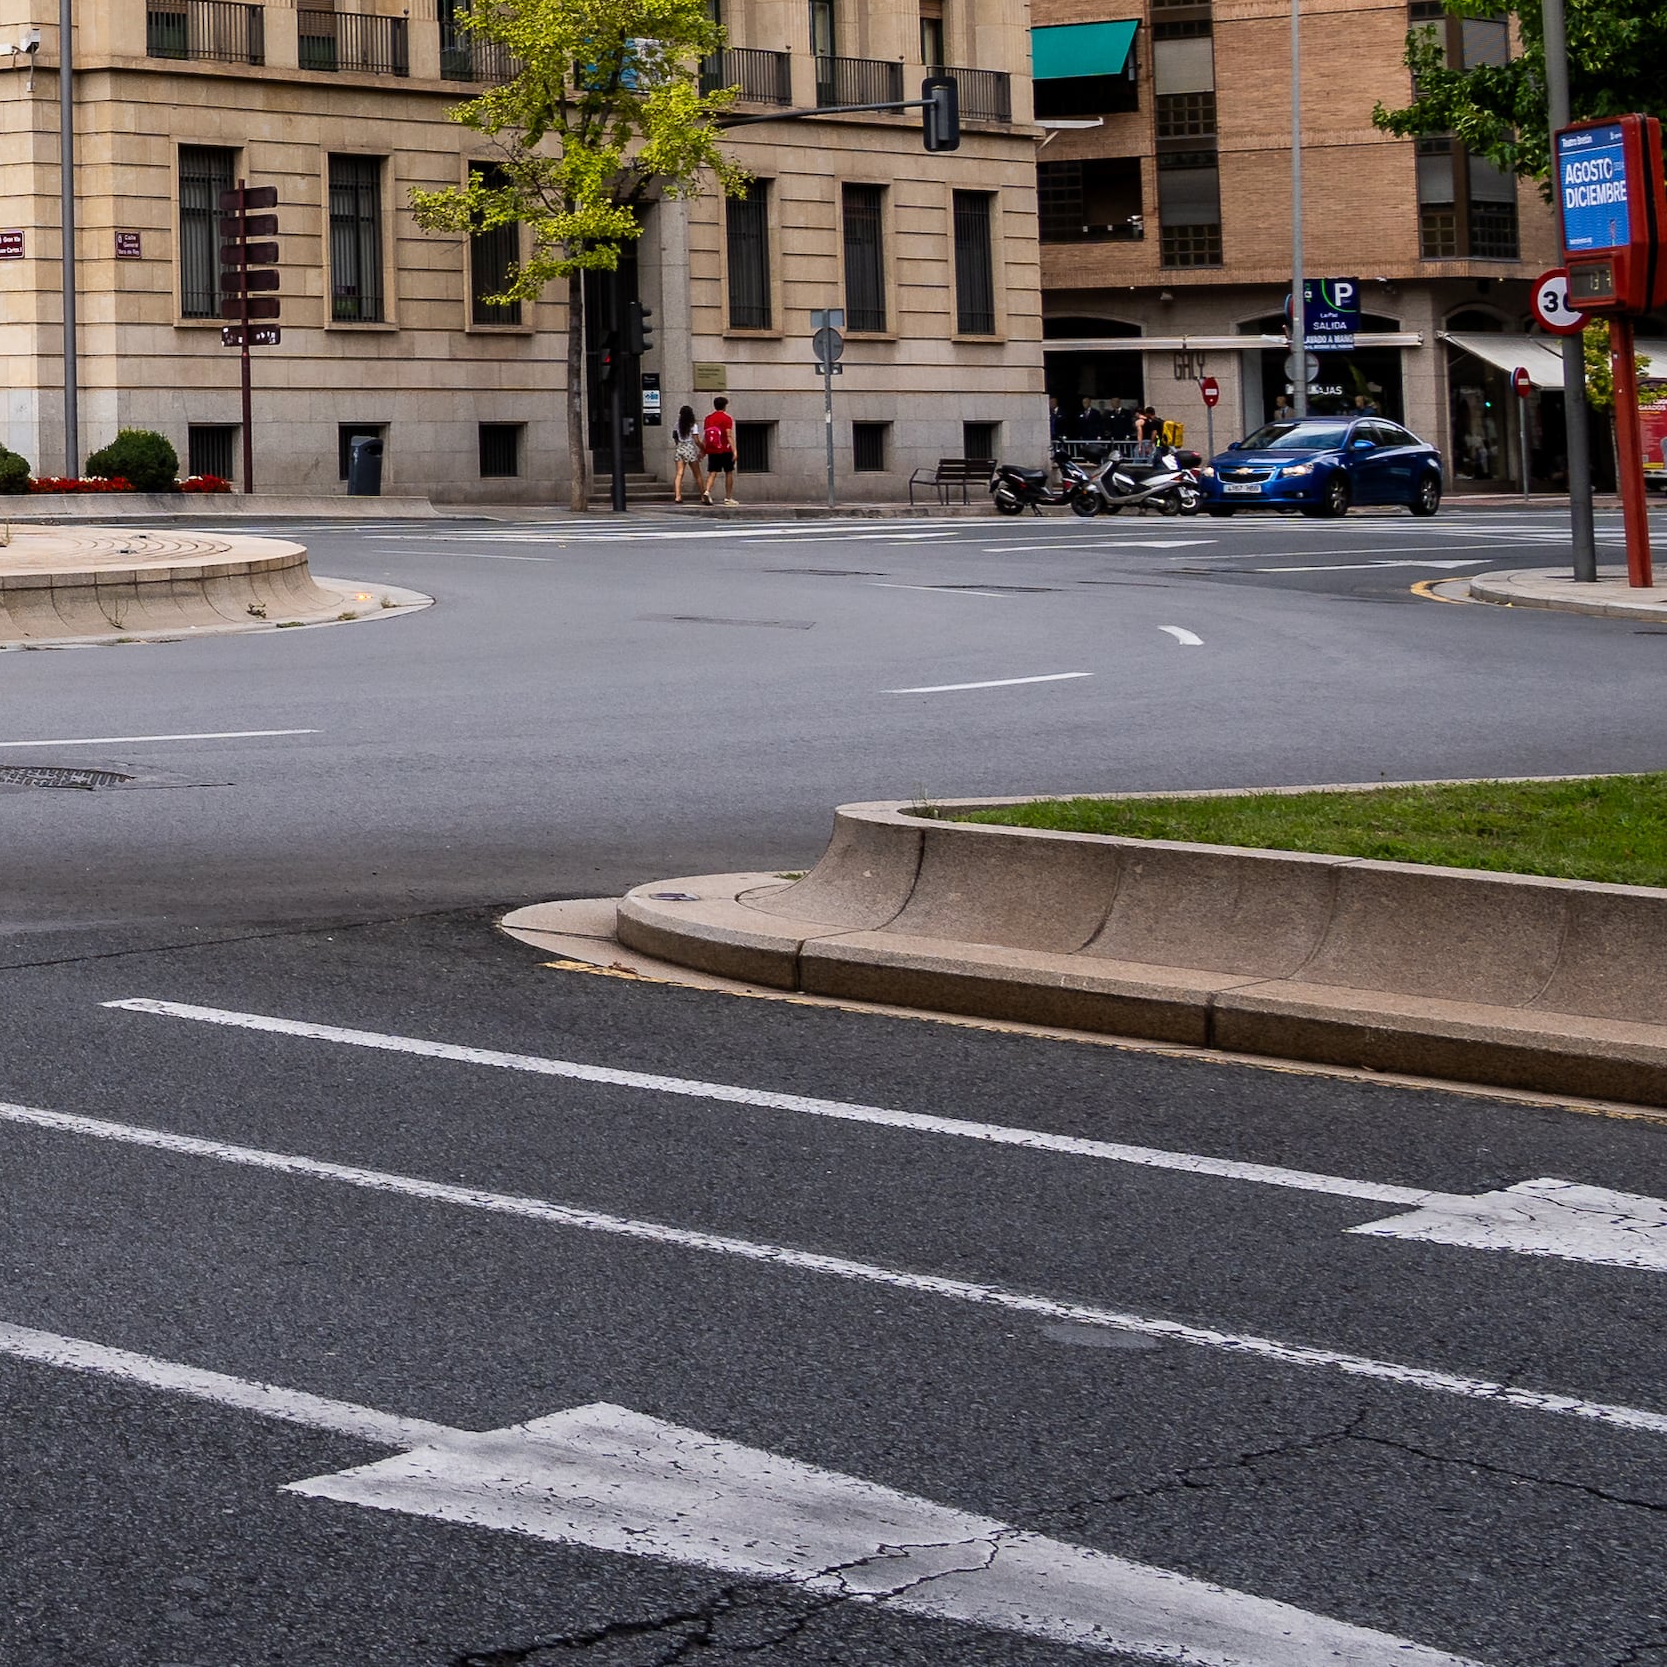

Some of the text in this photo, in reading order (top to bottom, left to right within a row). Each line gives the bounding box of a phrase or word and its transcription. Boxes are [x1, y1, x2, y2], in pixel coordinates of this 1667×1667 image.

[1565, 158, 1613, 184] AGOSTO
[1566, 180, 1627, 209] DICIEMBRE
[1334, 283, 1353, 306] P
[1313, 321, 1347, 330] SALIDA
